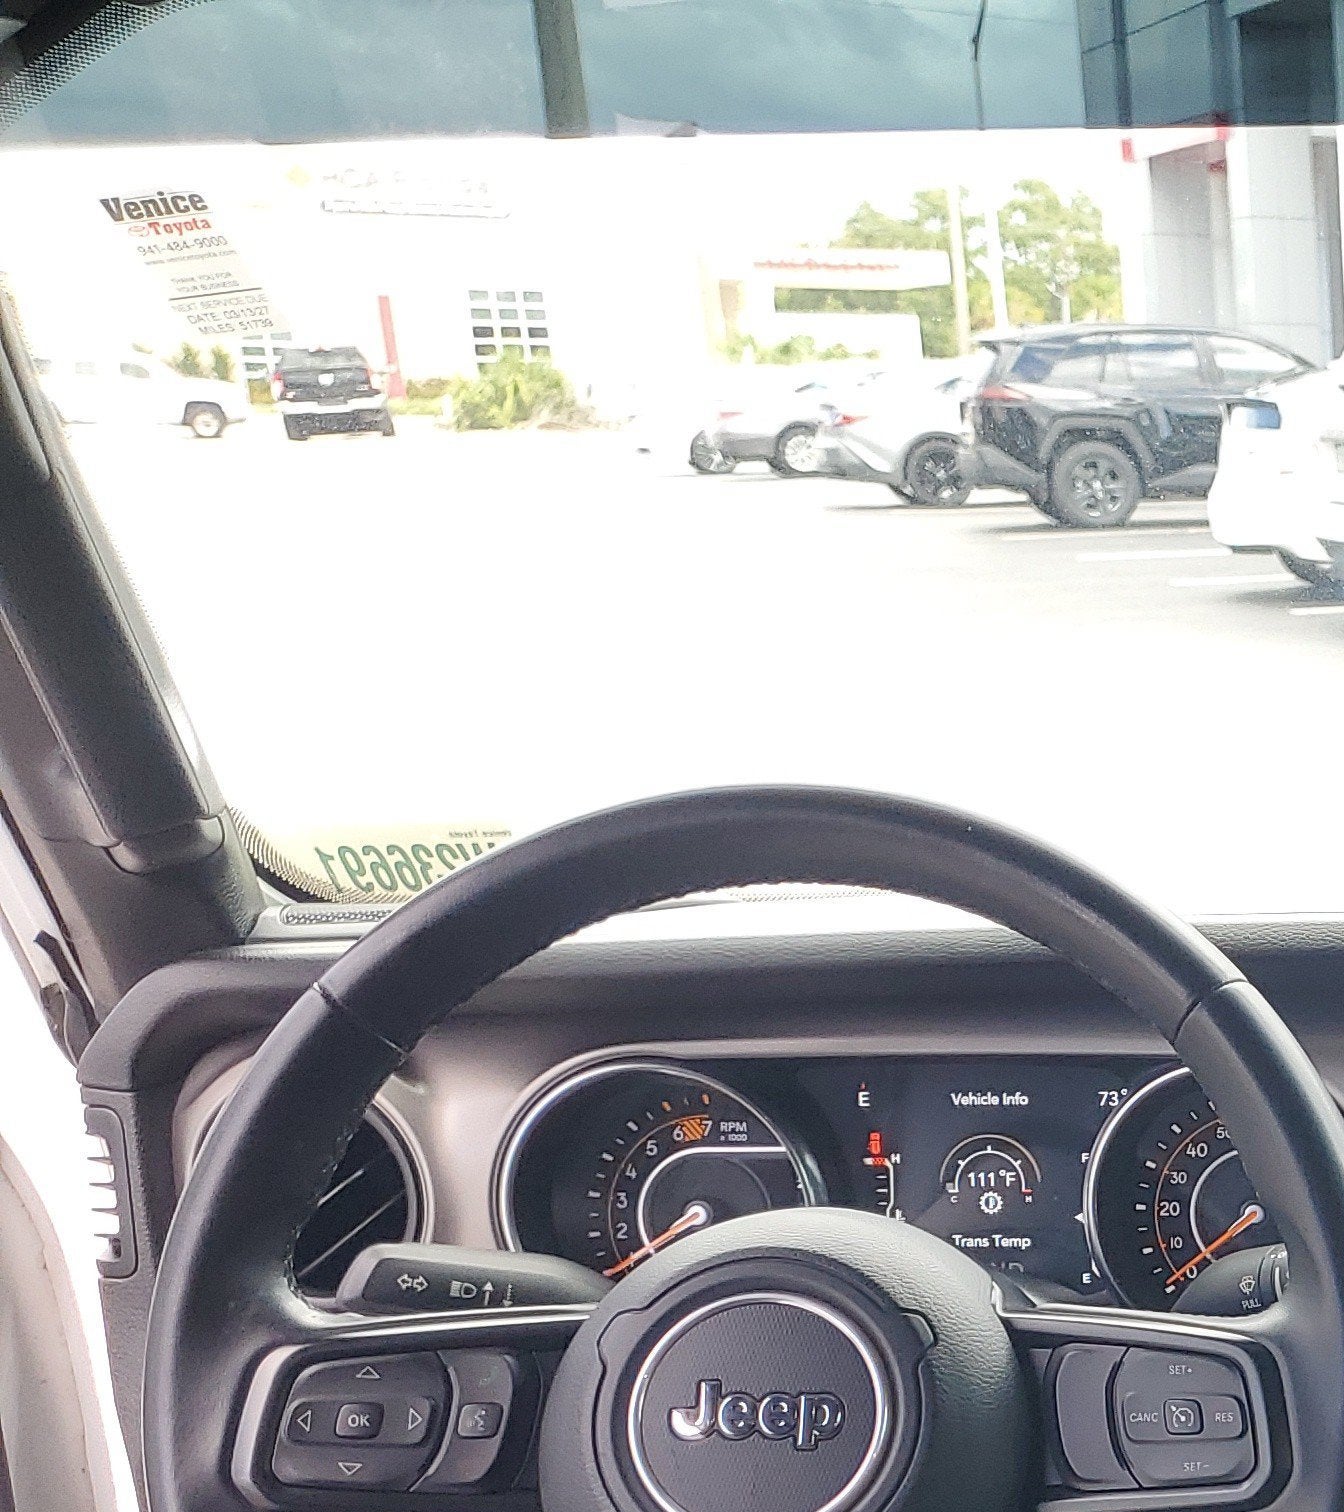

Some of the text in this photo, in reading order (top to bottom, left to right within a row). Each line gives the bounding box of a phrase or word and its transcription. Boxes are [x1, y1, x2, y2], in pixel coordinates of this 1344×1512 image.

[99, 191, 208, 222] Venice
[148, 218, 212, 236] Toyota
[137, 235, 228, 256] 941-484-9000
[201, 296, 244, 309] SERVICE
[187, 312, 221, 325] DATE
[199, 322, 235, 335] MILES
[858, 1092, 870, 1107] E
[950, 1092, 1029, 1106] Vehicle Info
[672, 1126, 684, 1141] 6
[703, 1120, 713, 1136] 7
[720, 1121, 748, 1132] RPM
[646, 1140, 658, 1156] 5
[1186, 1143, 1208, 1158] 40
[625, 1164, 637, 1179] 4
[967, 1169, 1017, 1188] 111°F
[1169, 1171, 1188, 1185] 30
[616, 1191, 628, 1209] 3
[1159, 1201, 1181, 1217] 20
[616, 1223, 628, 1239] 2
[952, 1234, 1032, 1250] Trans Temp
[1170, 1236, 1183, 1249] 10
[1082, 1273, 1091, 1284] E
[1186, 1265, 1198, 1279] 0
[347, 1413, 371, 1428] OK
[668, 1378, 847, 1451] Jeep
[1129, 1411, 1158, 1424] CANC
[1214, 1411, 1234, 1424] RES
